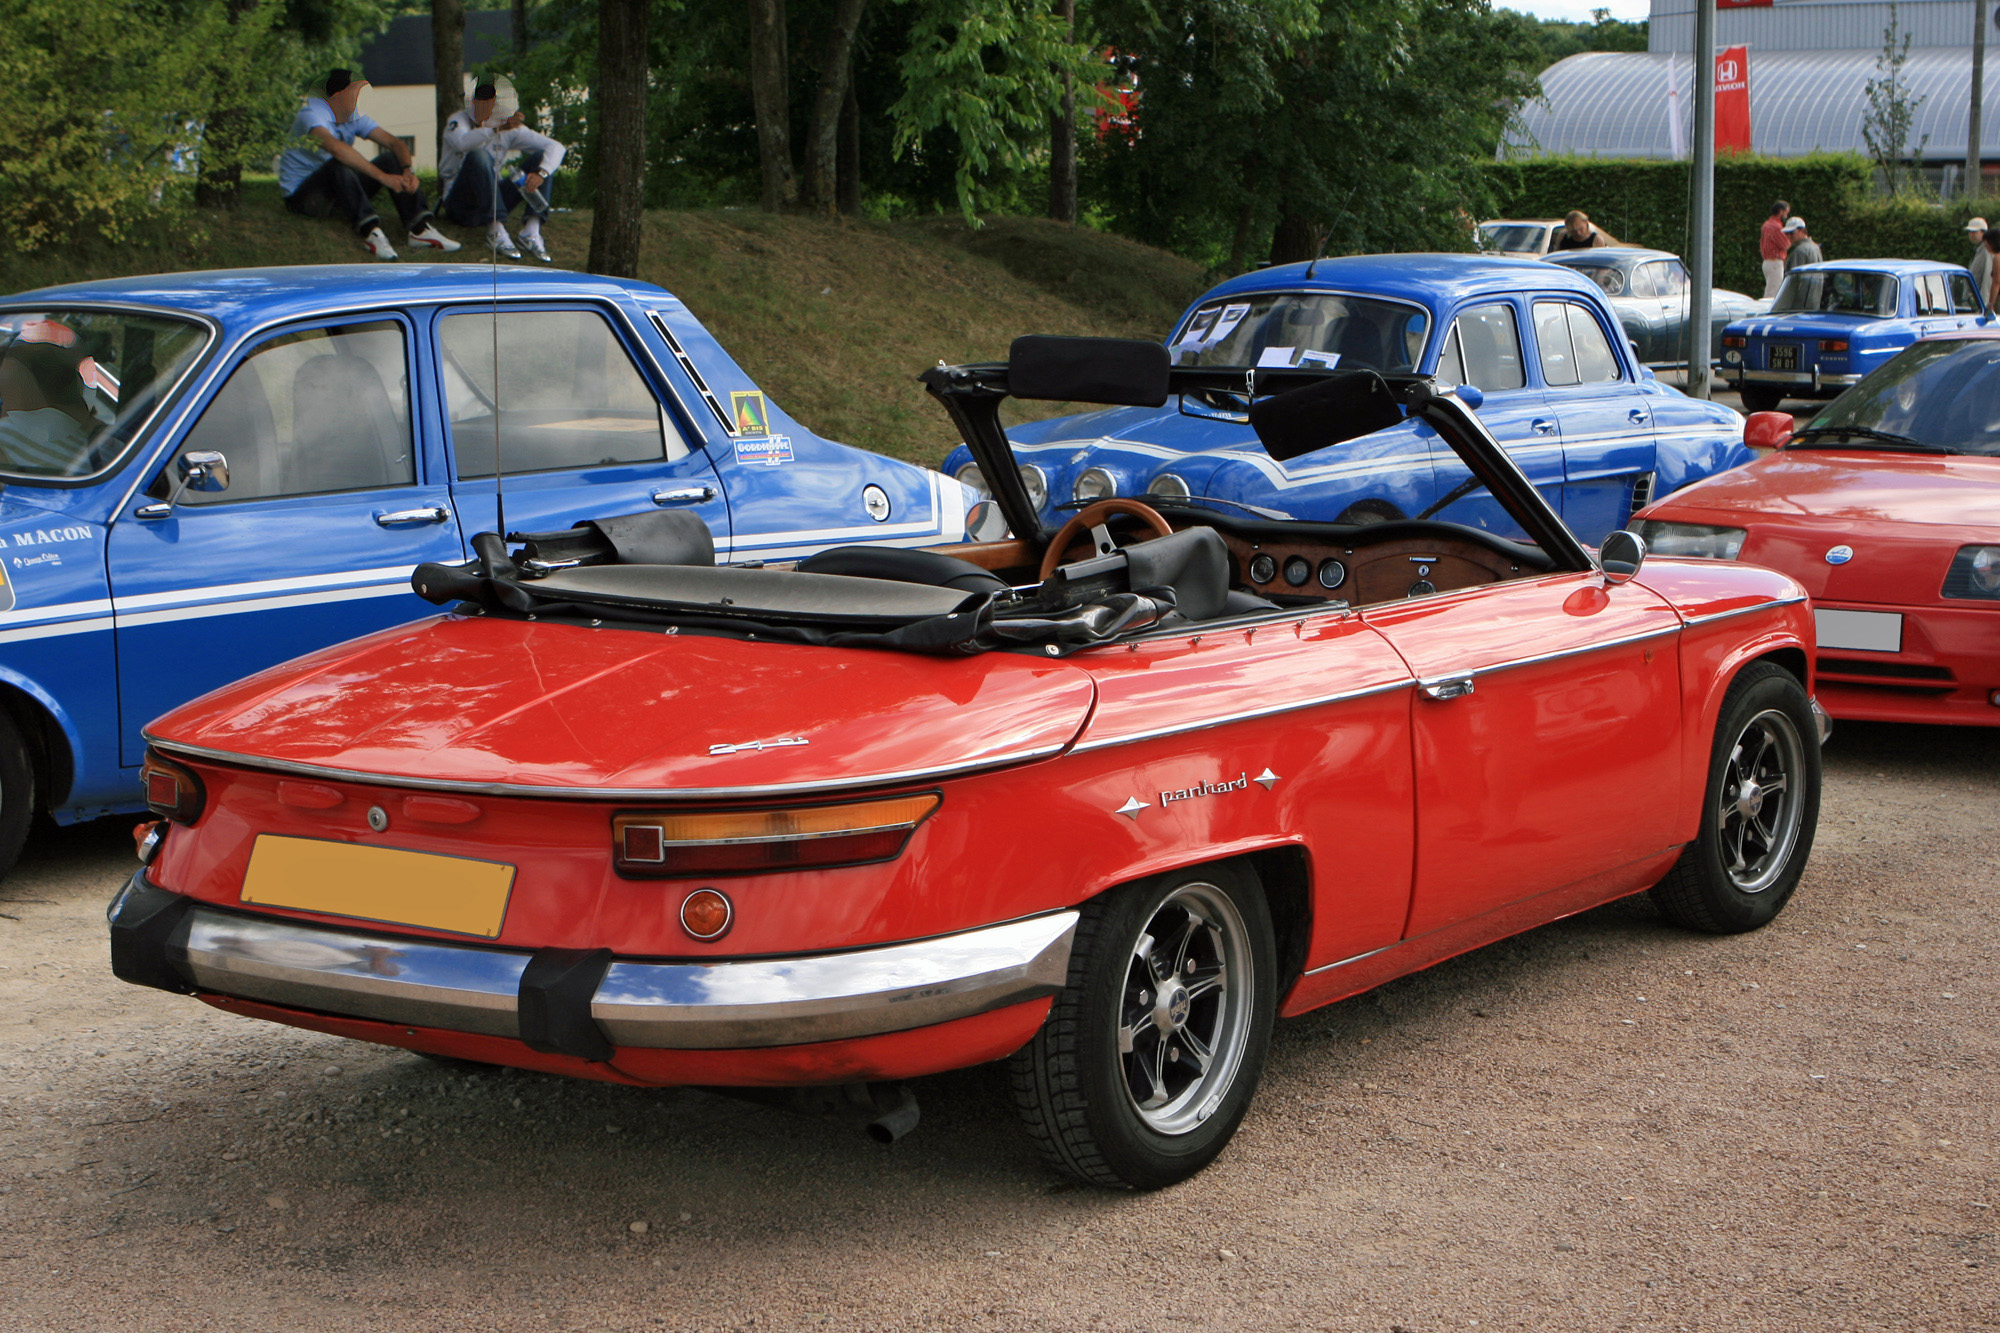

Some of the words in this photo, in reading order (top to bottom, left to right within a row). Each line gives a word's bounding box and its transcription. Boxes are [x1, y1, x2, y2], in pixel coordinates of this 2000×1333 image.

[1774, 346, 1793, 358] 3596
[1784, 358, 1794, 369] 01
[12, 525, 93, 547] MACON
[1160, 771, 1248, 808] panhard
